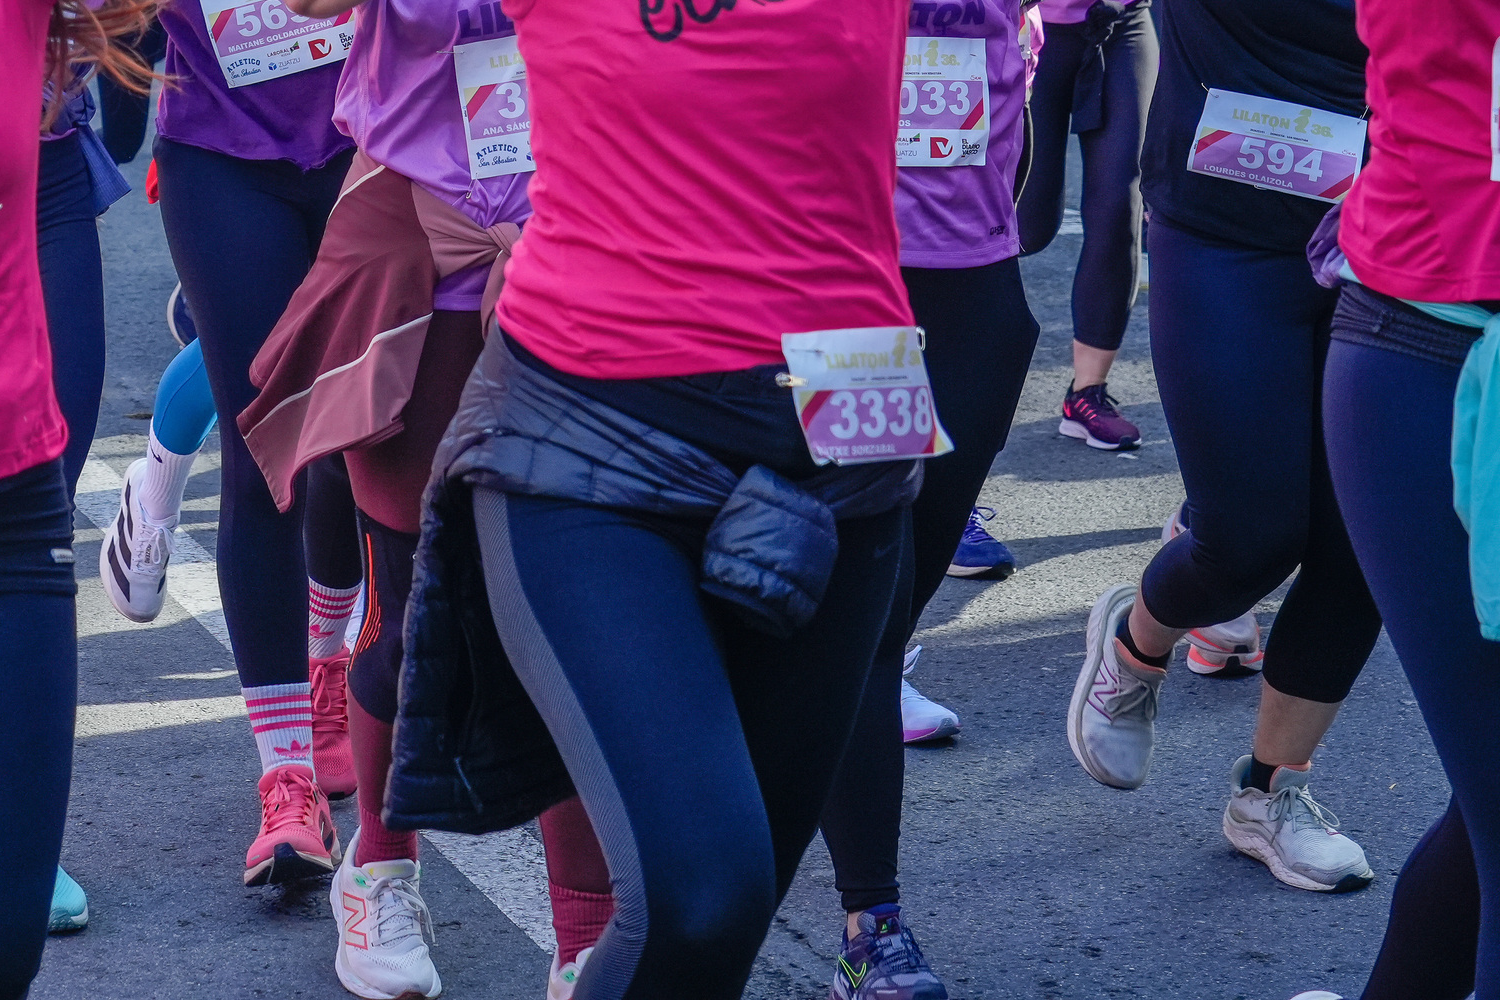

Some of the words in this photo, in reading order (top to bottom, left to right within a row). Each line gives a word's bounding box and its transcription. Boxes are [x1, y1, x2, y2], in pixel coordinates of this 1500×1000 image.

[228, 37, 265, 54] MAITANE
[266, 19, 333, 43] GOLDARATZENA
[226, 57, 261, 74] ATLETICO
[1232, 107, 1291, 130] LILATON
[482, 125, 505, 136] ANA
[475, 143, 519, 160] ATLETICO
[478, 157, 491, 168] San
[491, 155, 517, 166] Sebastian
[1236, 136, 1324, 183] 594
[1203, 163, 1247, 179] LOURDES
[1248, 171, 1294, 189] OLAIZOLA
[824, 350, 890, 370] LILATON
[829, 387, 933, 440] 3338
